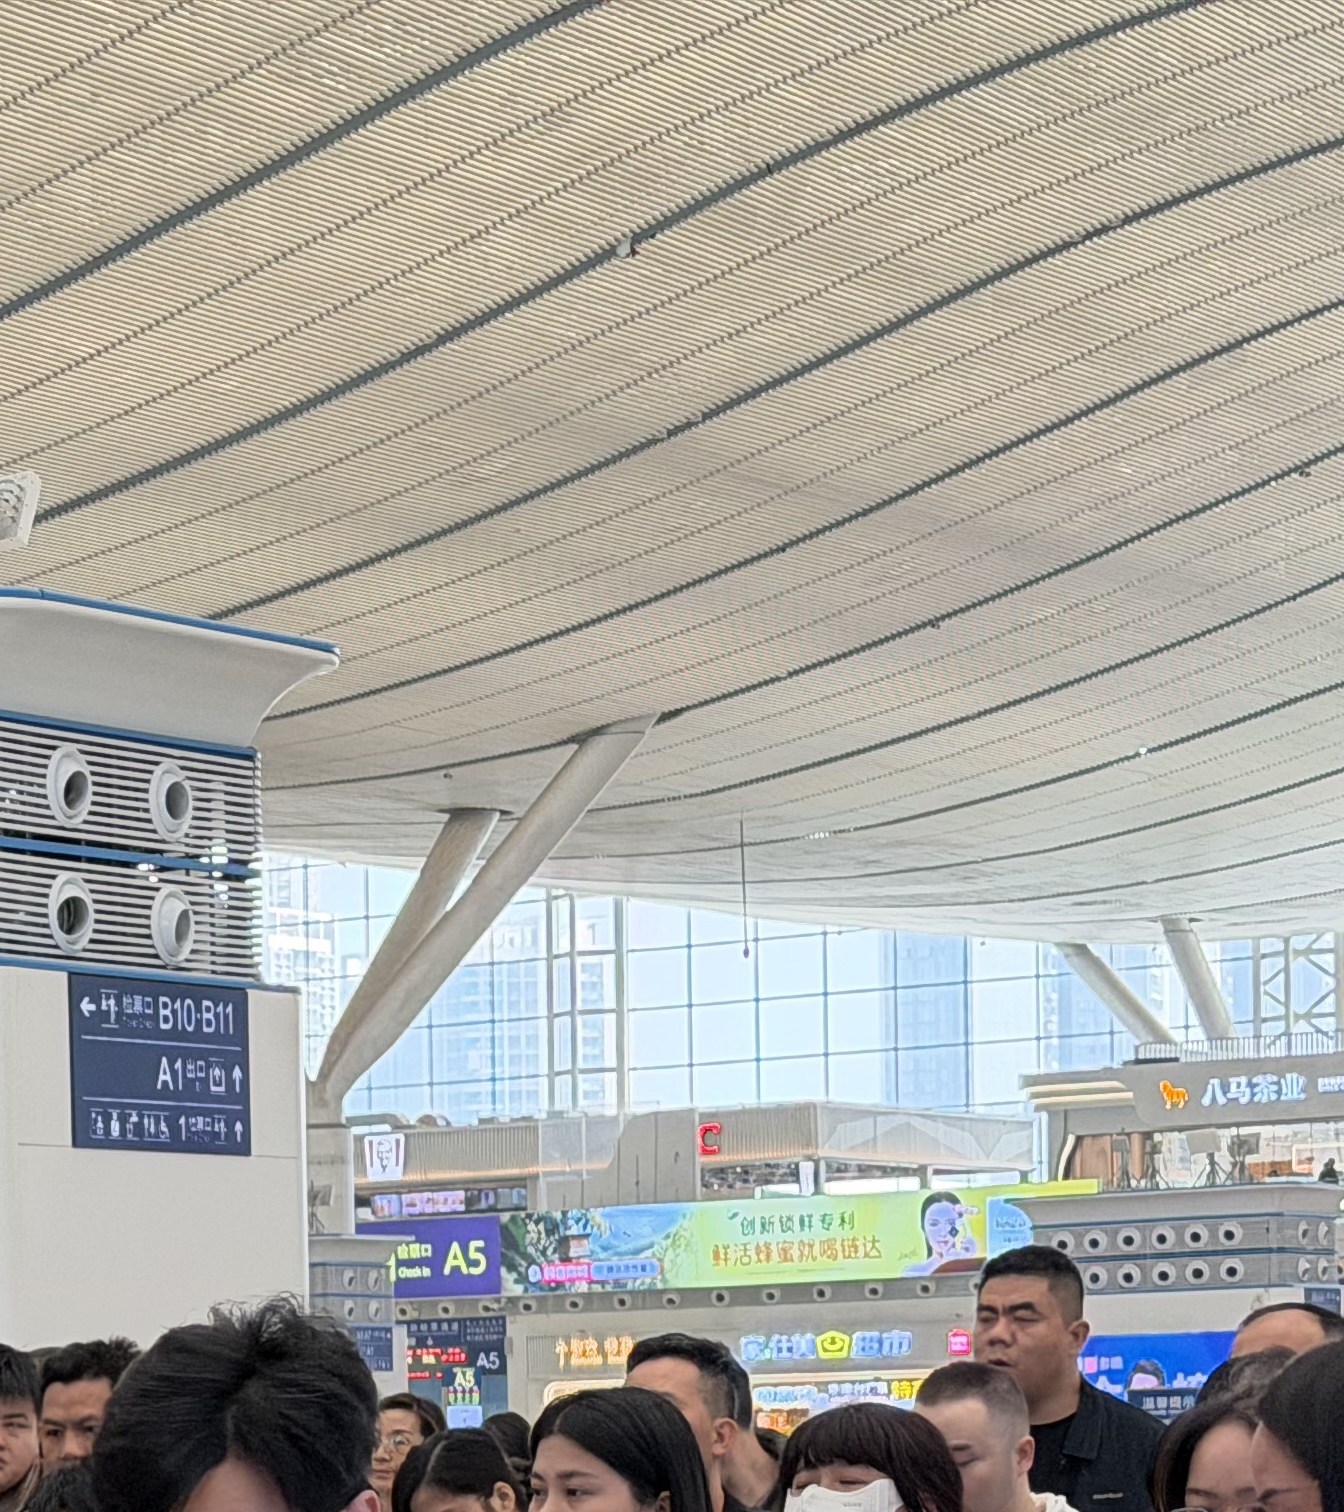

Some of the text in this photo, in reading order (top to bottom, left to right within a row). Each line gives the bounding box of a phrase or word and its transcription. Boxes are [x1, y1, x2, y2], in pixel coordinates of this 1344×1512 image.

[157, 1056, 206, 1091] A1 出口
[1201, 1072, 1307, 1107] 八马茶业
[740, 1209, 856, 1237] 创新锁鲜专利
[397, 1240, 487, 1276] 检票口 A5
[851, 1330, 912, 1358] 超市
[477, 1351, 500, 1370] A5
[454, 1370, 475, 1388] A5
